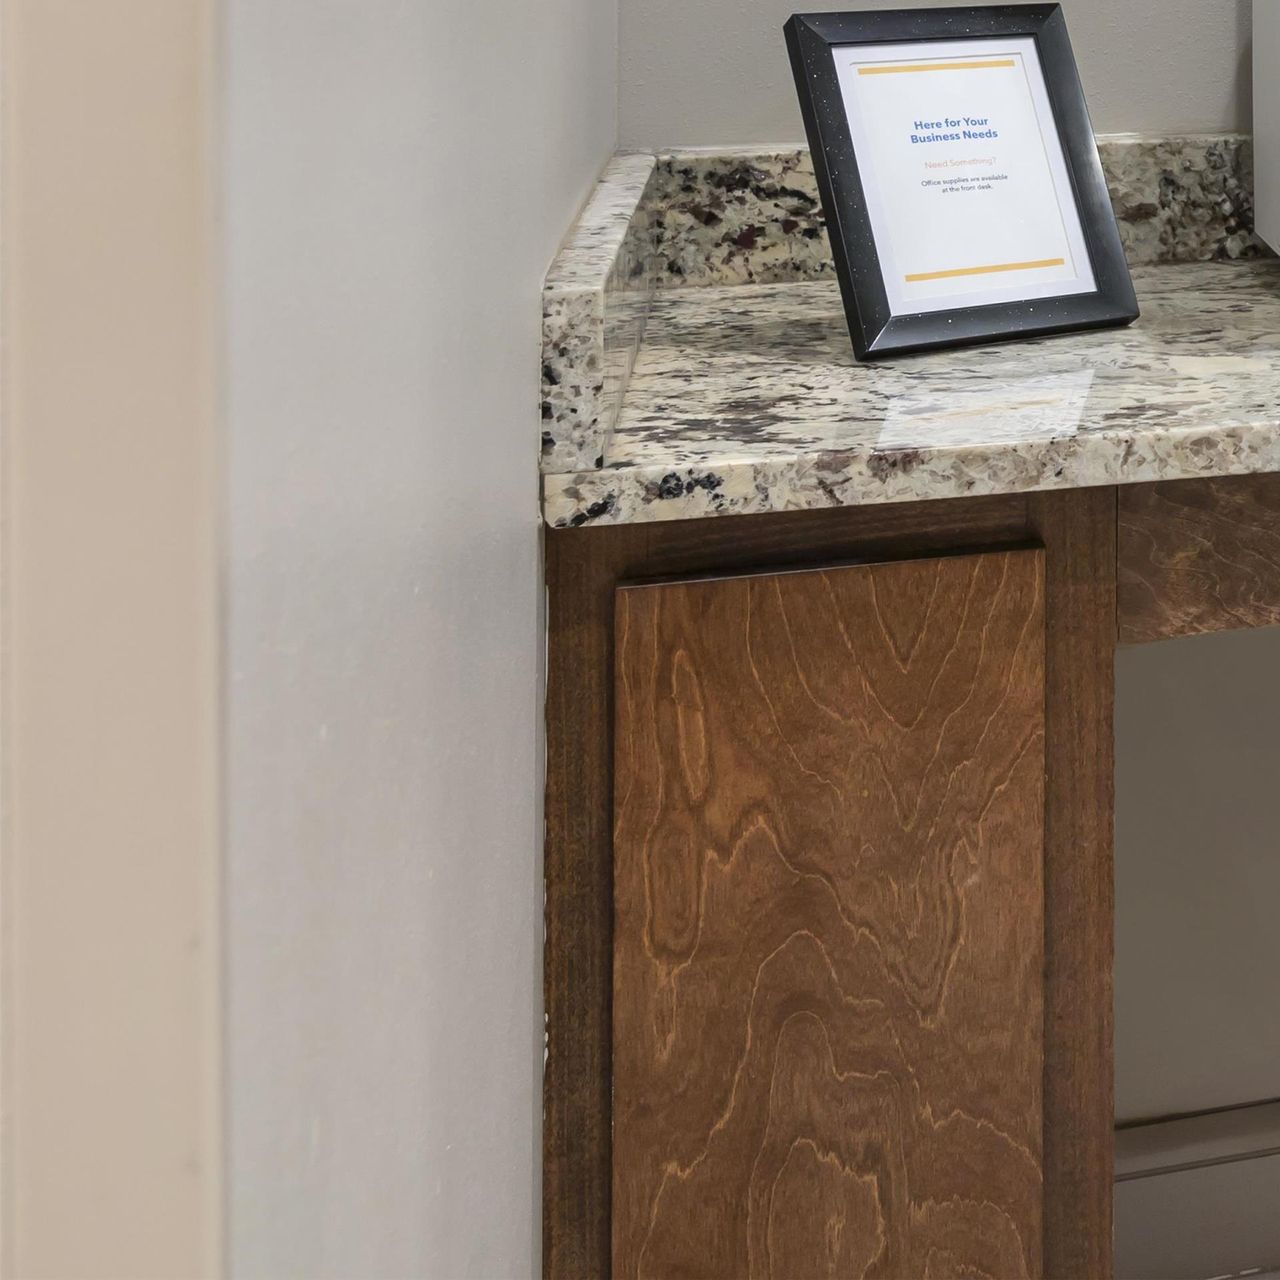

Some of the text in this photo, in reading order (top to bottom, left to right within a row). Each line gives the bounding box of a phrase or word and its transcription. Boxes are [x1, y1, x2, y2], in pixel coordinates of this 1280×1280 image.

[914, 117, 989, 130] Here for Your
[910, 129, 998, 144] Business Needs
[924, 159, 948, 168] Need
[942, 177, 969, 185] supplies
